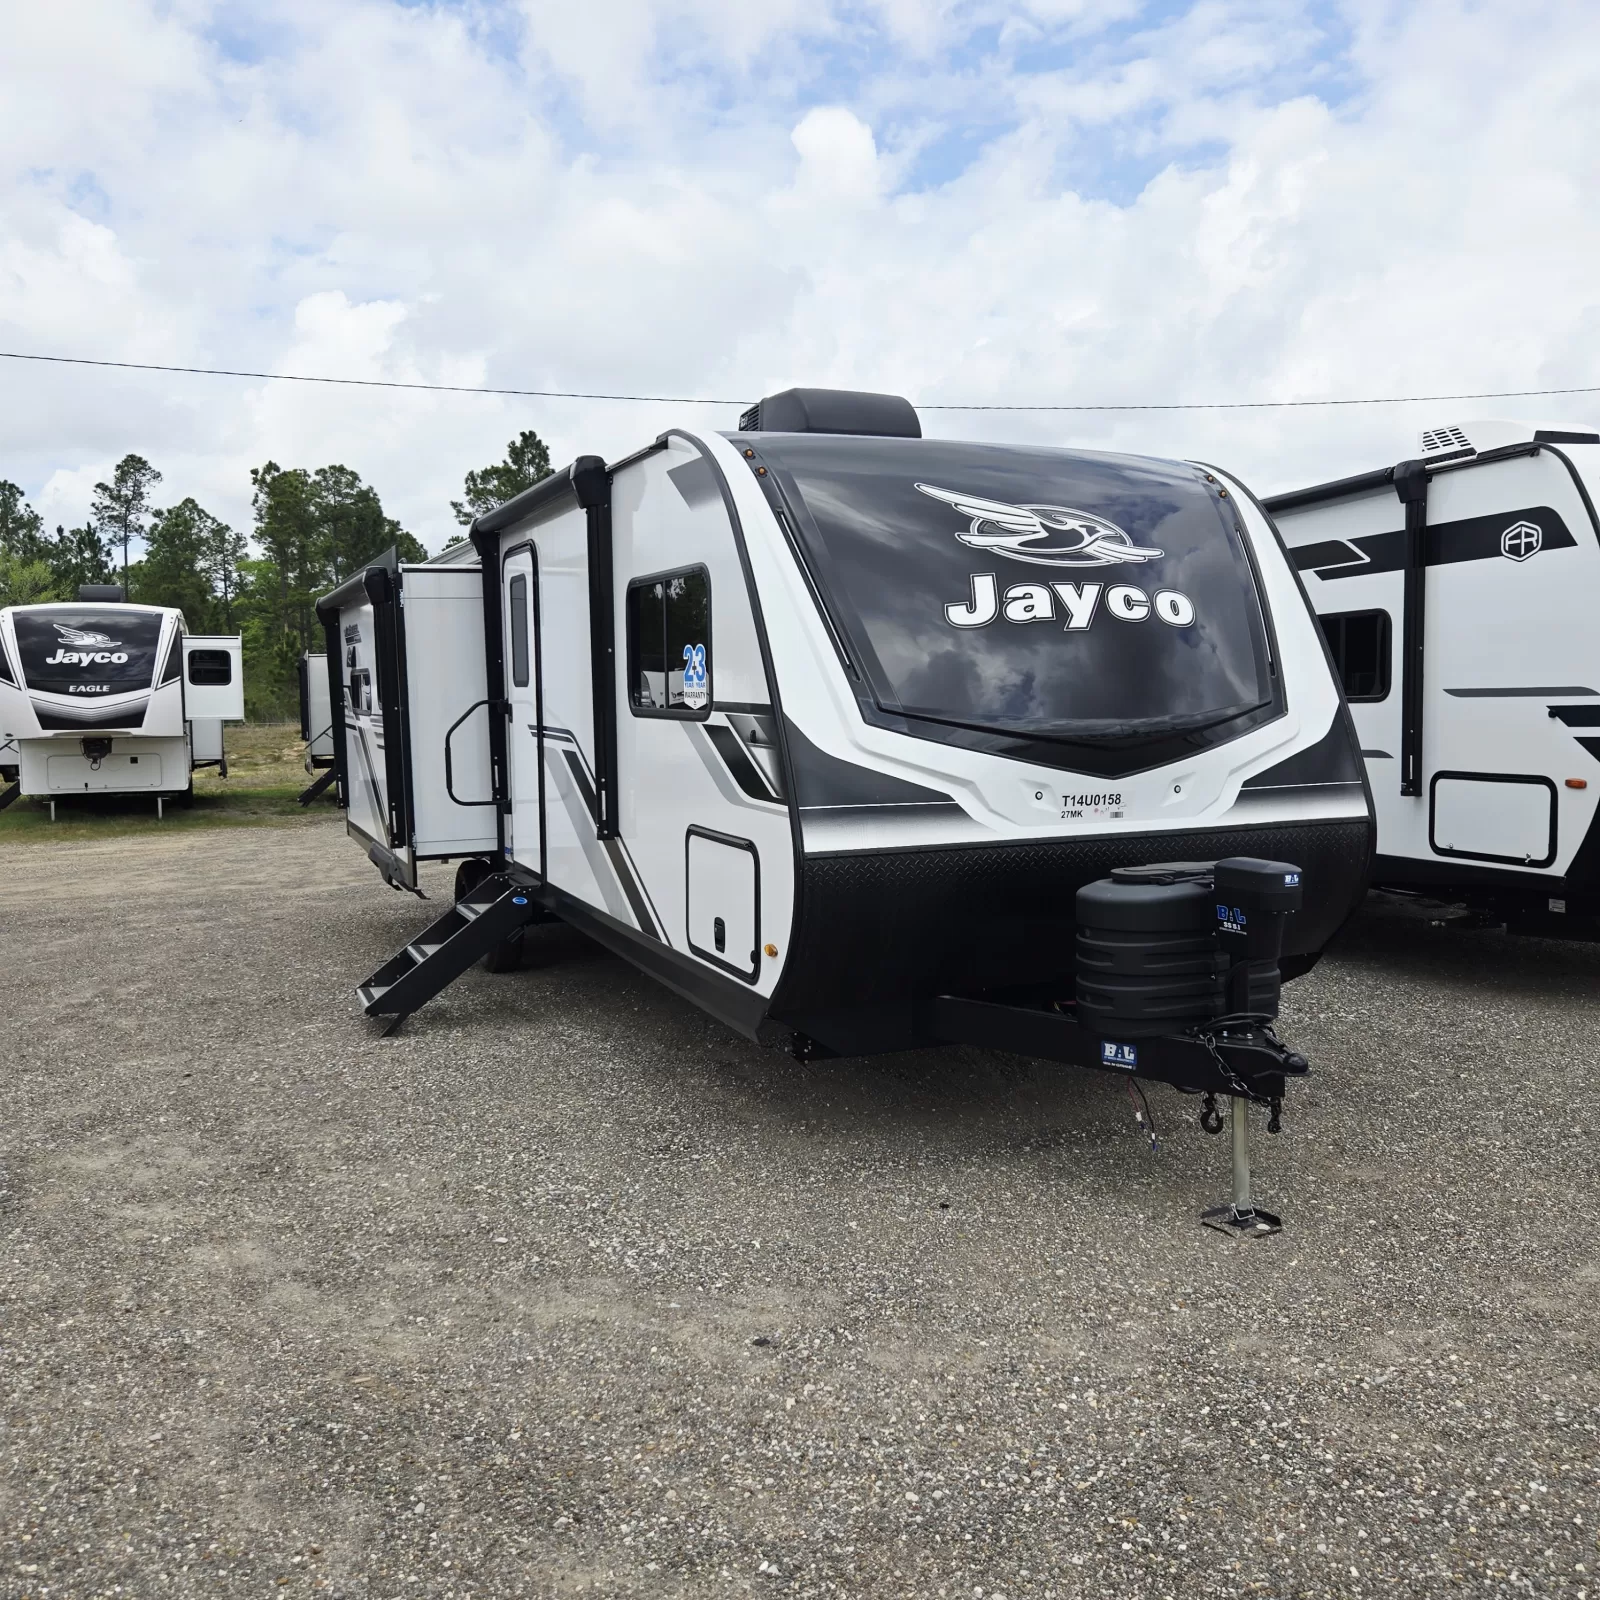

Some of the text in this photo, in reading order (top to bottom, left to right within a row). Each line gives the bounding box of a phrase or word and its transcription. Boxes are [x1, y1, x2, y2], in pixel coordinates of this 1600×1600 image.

[945, 572, 1196, 631] Jayco
[45, 648, 129, 667] Jayco
[684, 691, 706, 699] WARRANTY
[1062, 793, 1122, 807] T14U0158
[1061, 810, 1084, 819] 27MK
